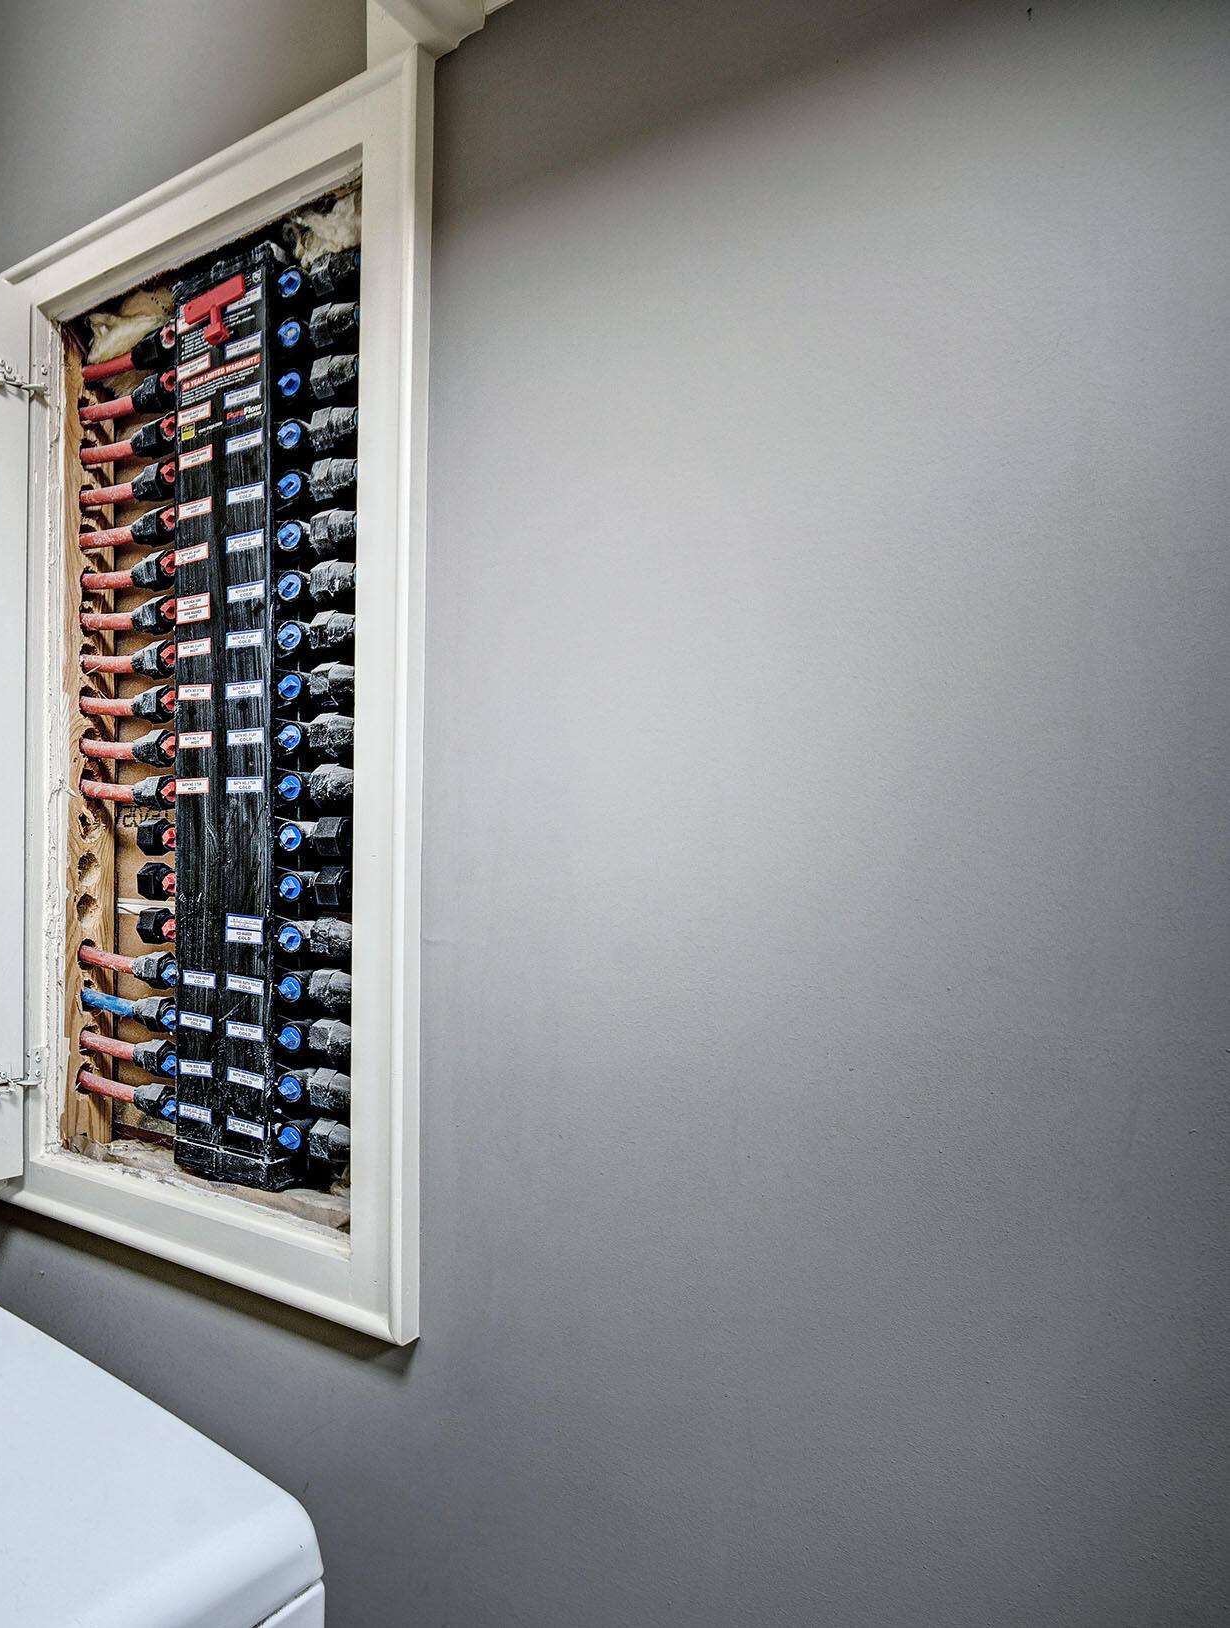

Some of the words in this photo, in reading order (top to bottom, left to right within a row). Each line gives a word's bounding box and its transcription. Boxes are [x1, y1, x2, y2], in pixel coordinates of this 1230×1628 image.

[191, 375, 204, 387] YEAR
[204, 368, 225, 380] LIMITED
[226, 356, 258, 372] WARRANTY
[227, 404, 262, 419] PureFlow
